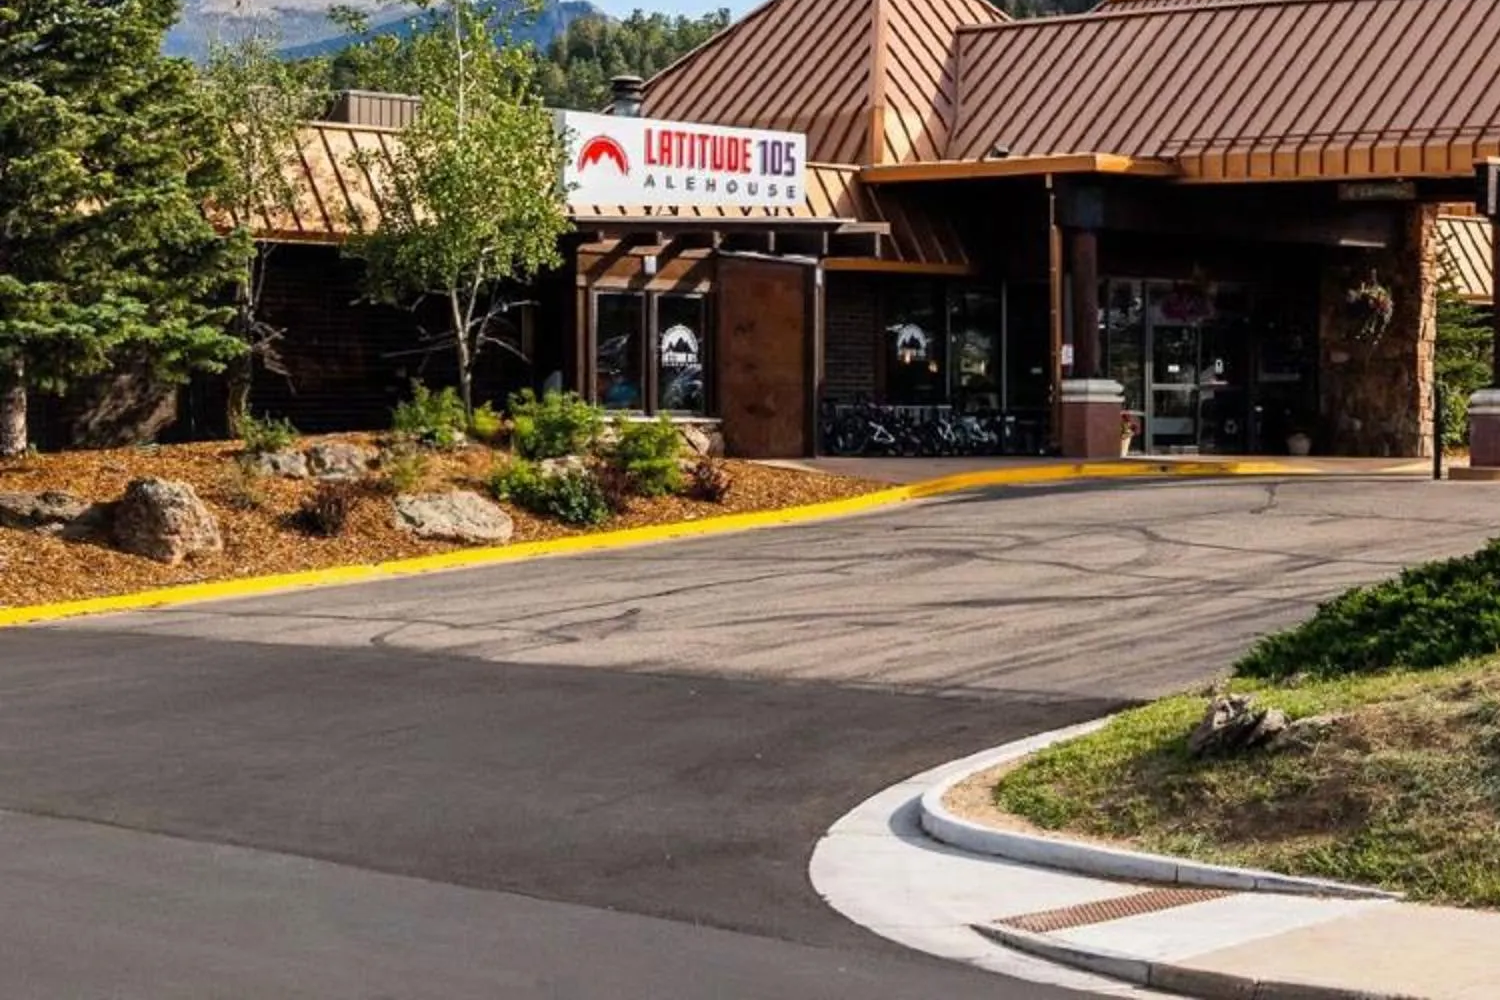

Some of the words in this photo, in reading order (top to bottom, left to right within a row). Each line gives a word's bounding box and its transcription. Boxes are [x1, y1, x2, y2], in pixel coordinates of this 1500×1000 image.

[644, 128, 752, 174] LATITUDE
[757, 140, 796, 177] 105
[644, 174, 796, 199] ALEHOUSE
